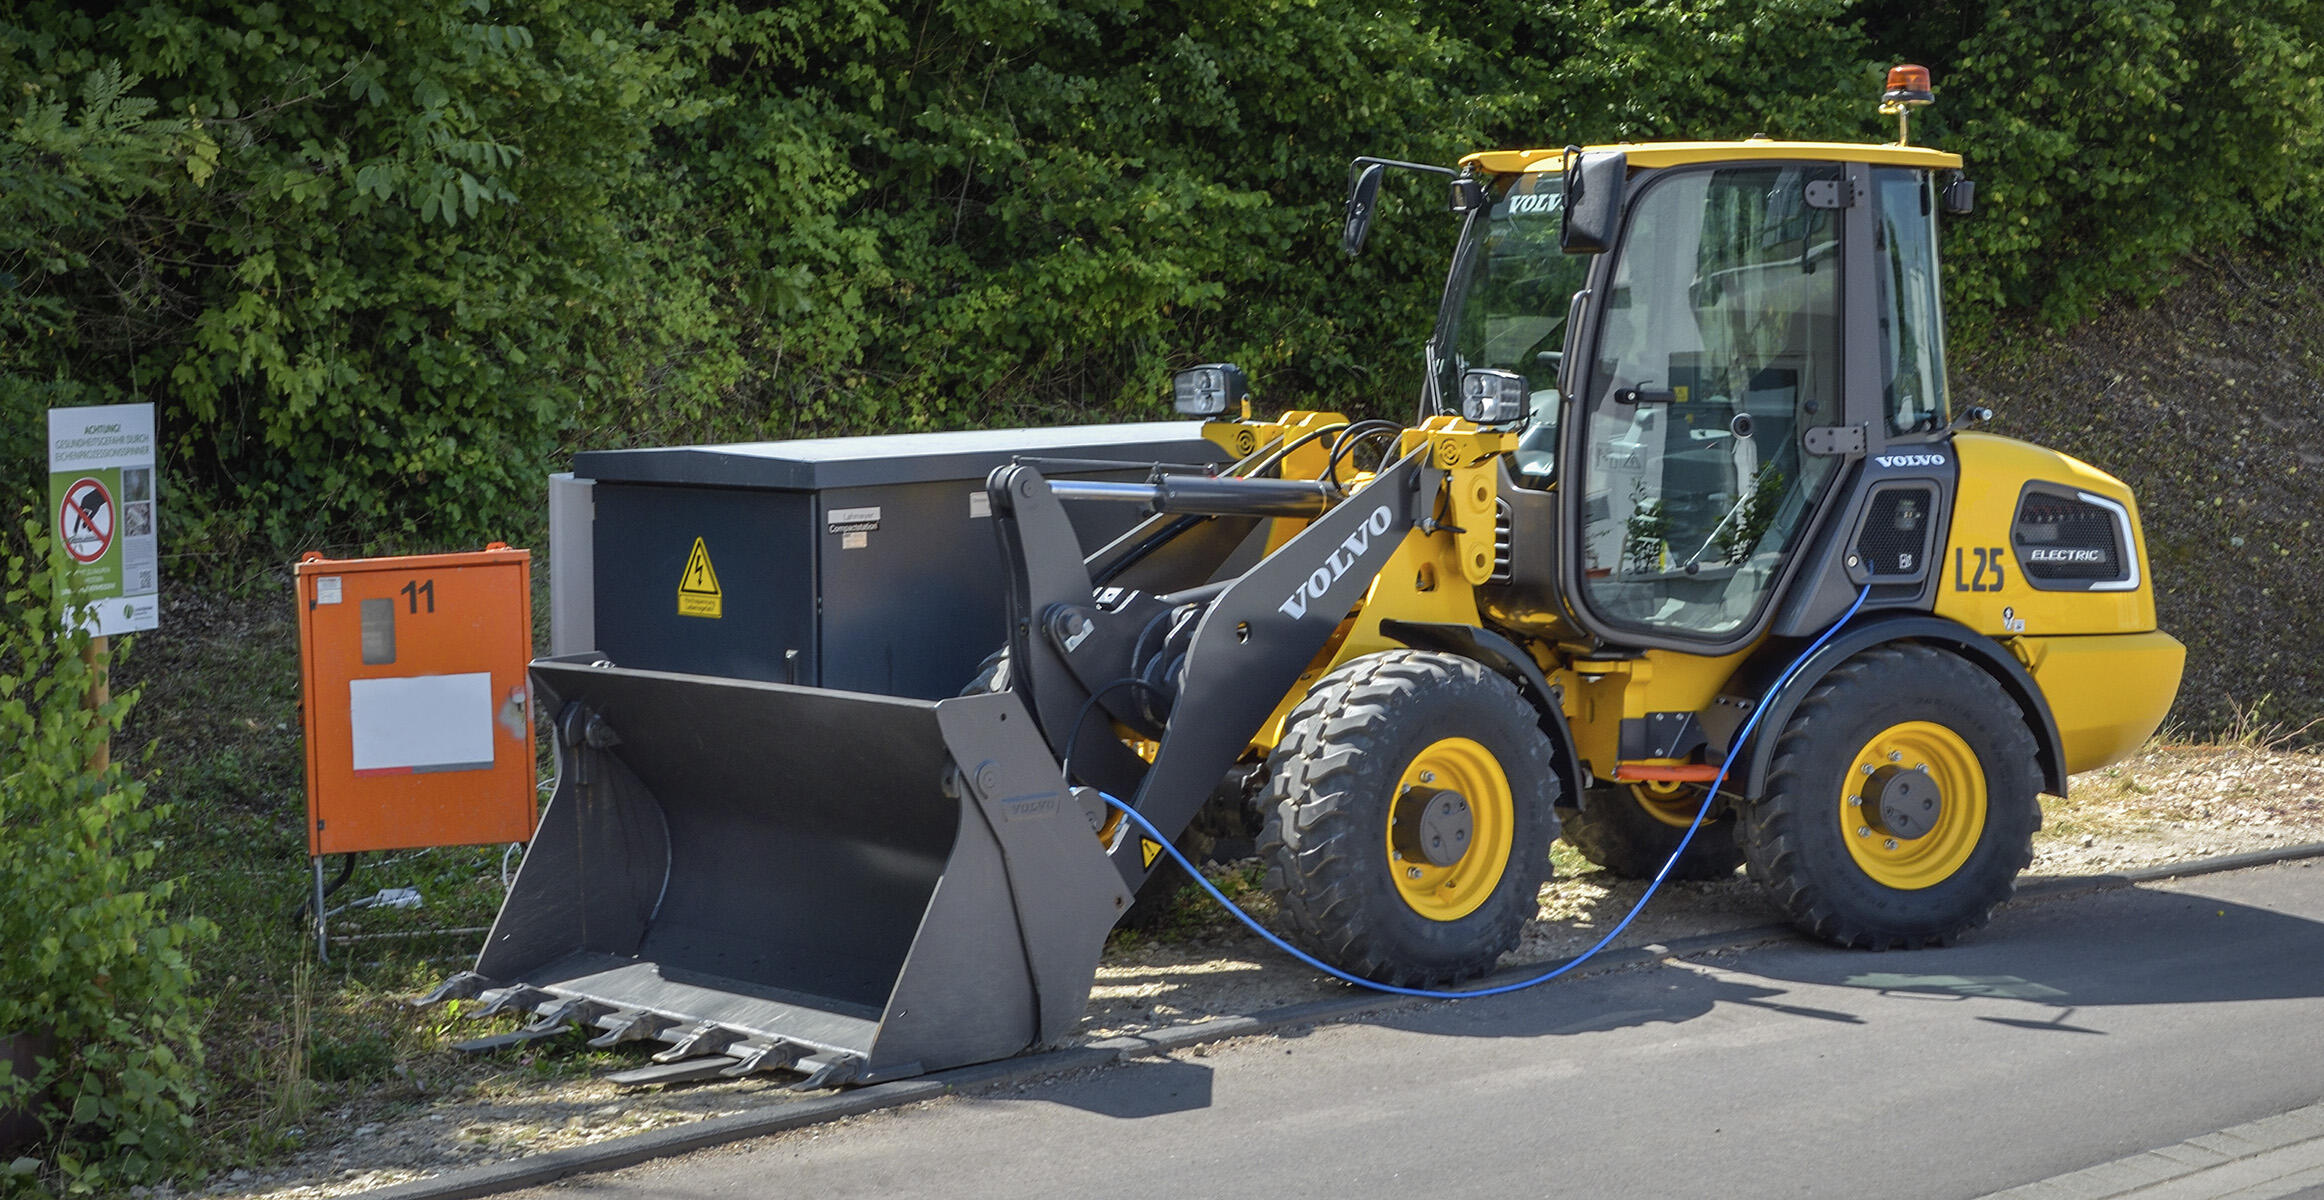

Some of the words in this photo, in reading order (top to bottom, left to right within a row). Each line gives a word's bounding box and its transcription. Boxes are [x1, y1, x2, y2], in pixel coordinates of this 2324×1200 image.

[1508, 193, 1566, 214] VOLV
[1875, 454, 1946, 468] VOLVO
[1278, 505, 1393, 620] VOLVO
[2031, 549, 2099, 561] ELECTRIC
[1955, 547, 2005, 592] L25
[401, 579, 434, 614] 11
[1012, 800, 1055, 815] VOLVO
